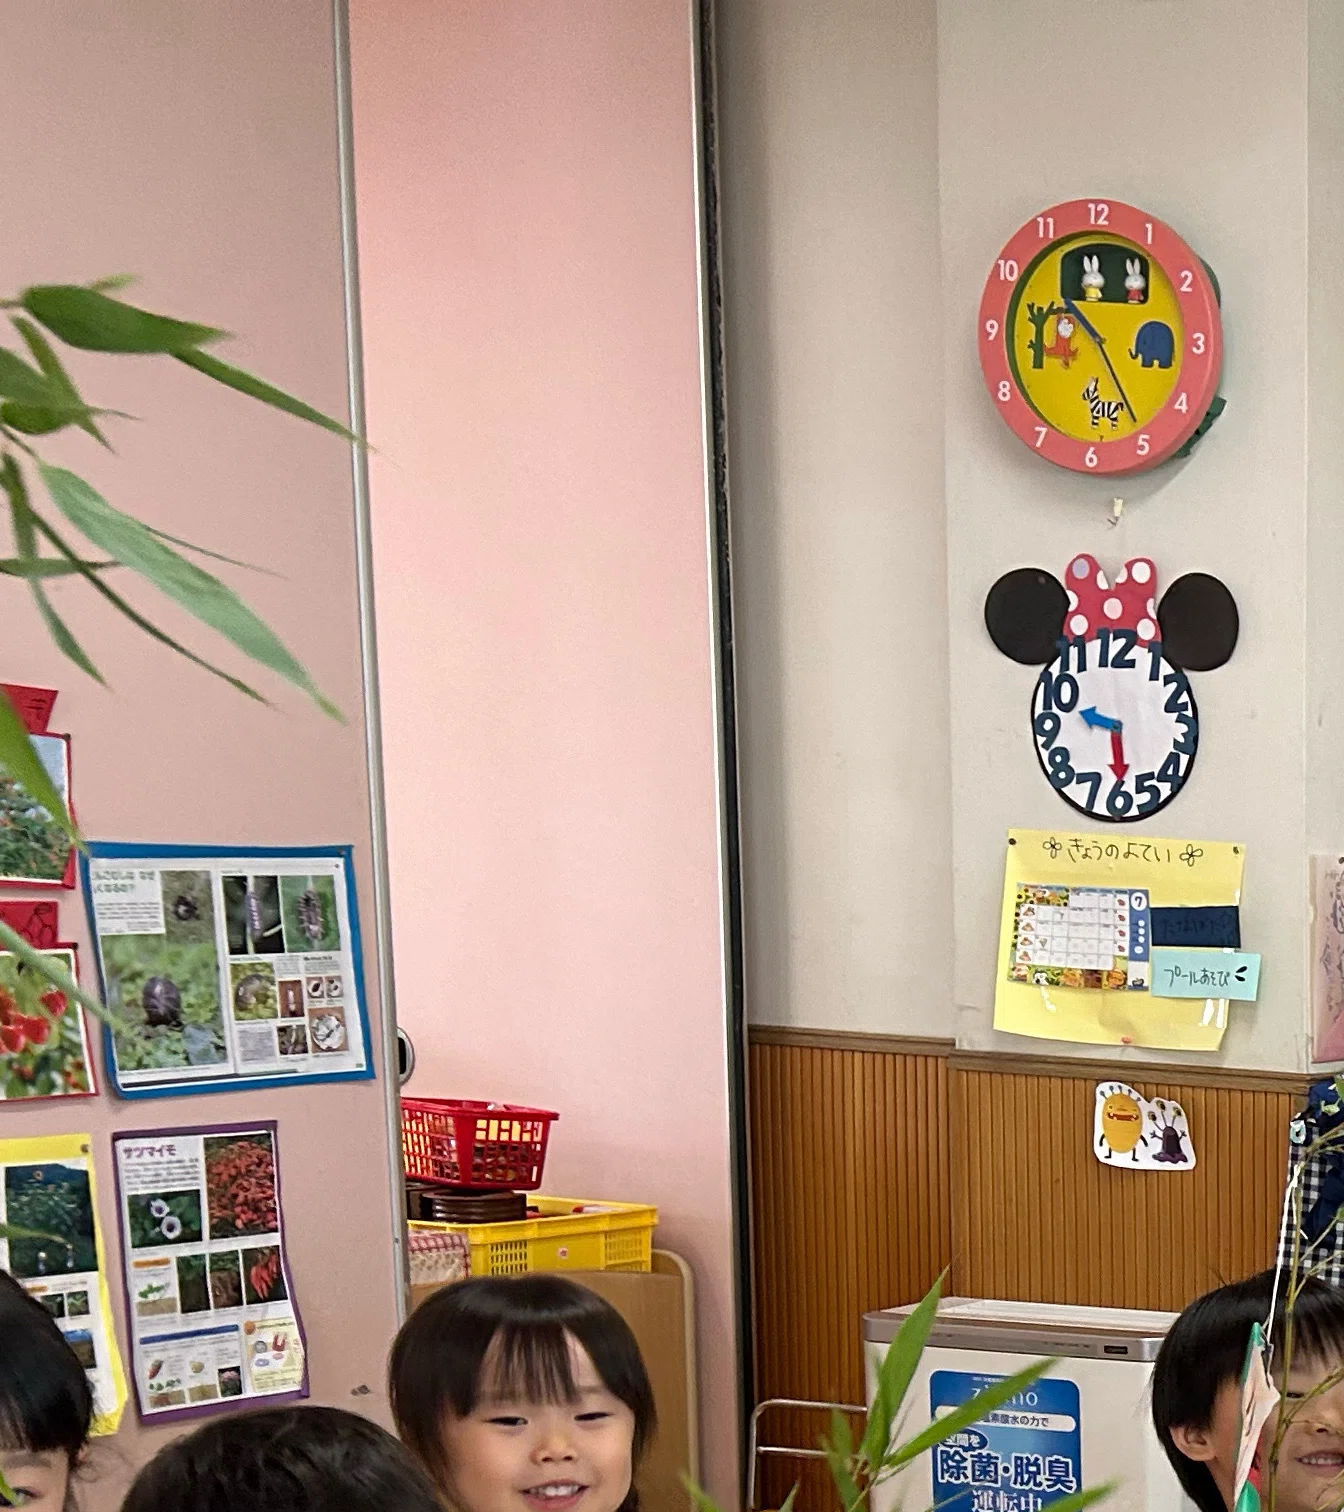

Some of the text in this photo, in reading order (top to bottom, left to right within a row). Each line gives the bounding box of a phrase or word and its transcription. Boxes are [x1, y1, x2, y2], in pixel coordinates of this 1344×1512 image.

[1088, 203, 1109, 226] 12
[1037, 217, 1054, 239] 11
[1145, 223, 1152, 244] 1
[998, 260, 1019, 281] 10
[1180, 271, 1193, 292] 2
[985, 319, 999, 341] 9
[1192, 333, 1205, 354] 3
[998, 380, 1011, 401] 8
[1174, 392, 1188, 413] 4
[1035, 427, 1048, 448] 7
[1137, 434, 1150, 455] 5
[1085, 446, 1098, 467] 6
[1056, 635, 1087, 673] 11
[1097, 627, 1138, 668] 12
[1147, 641, 1162, 681] 1
[1040, 670, 1079, 713] 10
[1163, 670, 1188, 713] 2
[1035, 711, 1061, 751] 9
[1173, 711, 1198, 755] 3
[1048, 746, 1075, 789] 8
[1156, 751, 1183, 793] 4
[1075, 771, 1102, 811] 7
[1106, 779, 1133, 817] 6
[1135, 771, 1161, 814] 5
[1067, 838, 1171, 863] きょうのよてい
[1134, 895, 1143, 909] 7
[1163, 966, 1230, 987] プールあそび
[938, 1447, 1077, 1494] 除菌・脱臭
